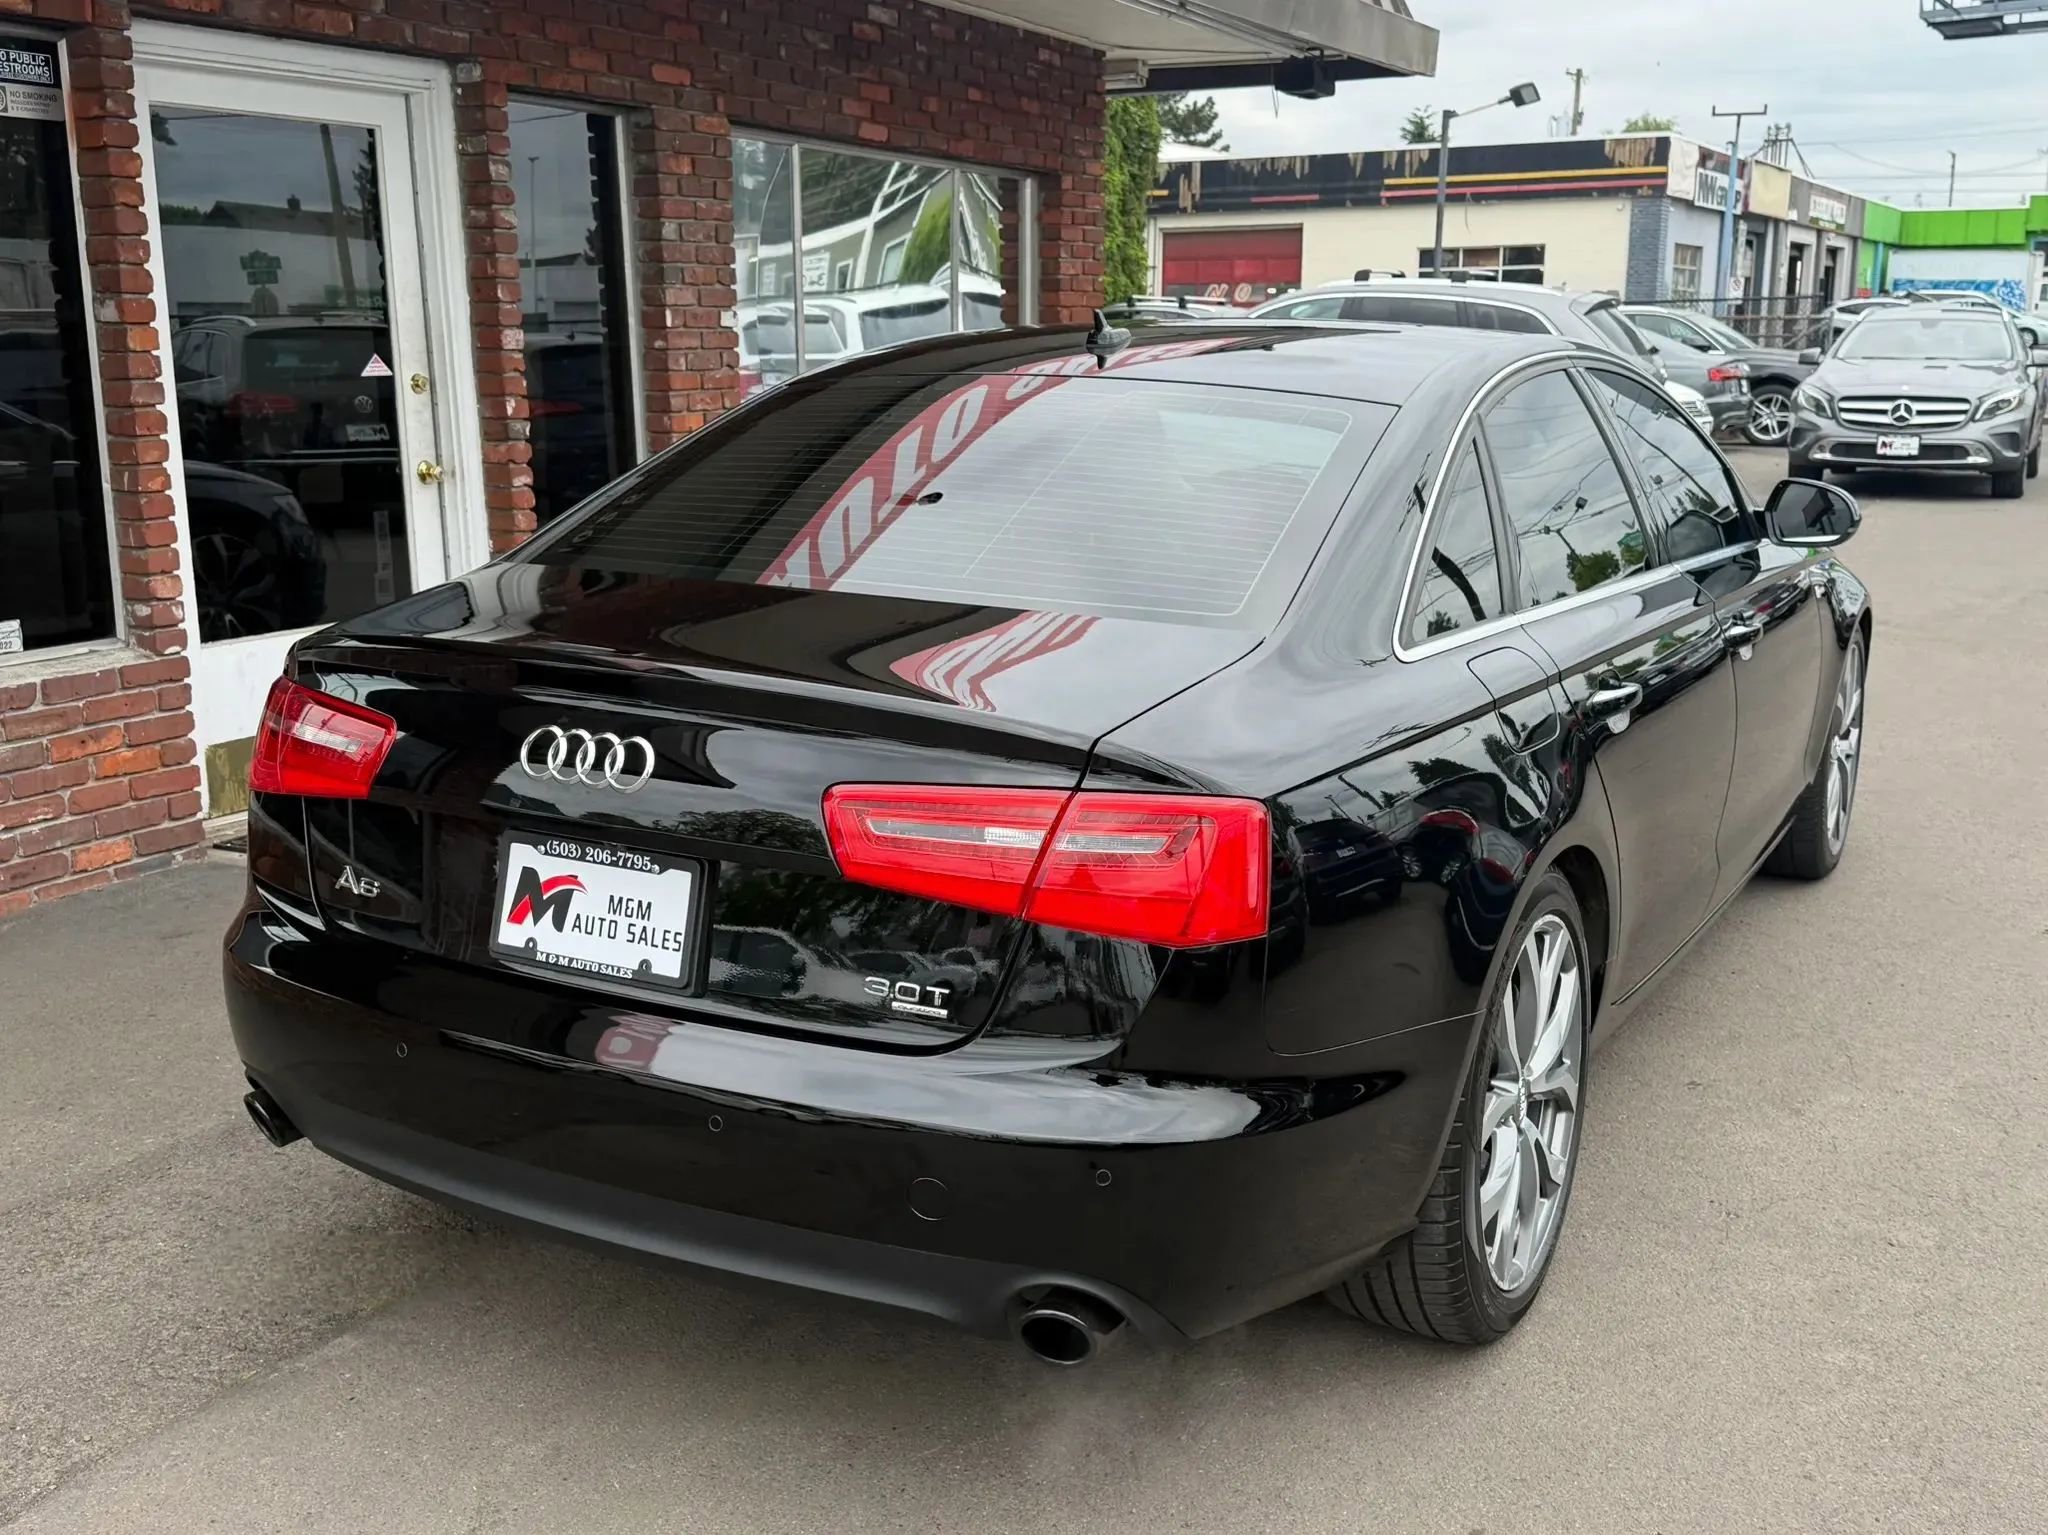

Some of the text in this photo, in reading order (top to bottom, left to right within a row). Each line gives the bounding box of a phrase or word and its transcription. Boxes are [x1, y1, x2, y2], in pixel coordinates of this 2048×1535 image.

[0, 51, 46, 66] O PUBLIC
[0, 61, 50, 77] ESTROOMS
[9, 90, 58, 103] NO SMOKING
[0, 641, 13, 649] 022
[545, 840, 651, 871] (503) 206-7795
[335, 865, 381, 898] A6
[607, 894, 653, 922] M&M
[571, 913, 683, 952] AUTO SALES
[536, 952, 633, 979] M & M AUTO SALES
